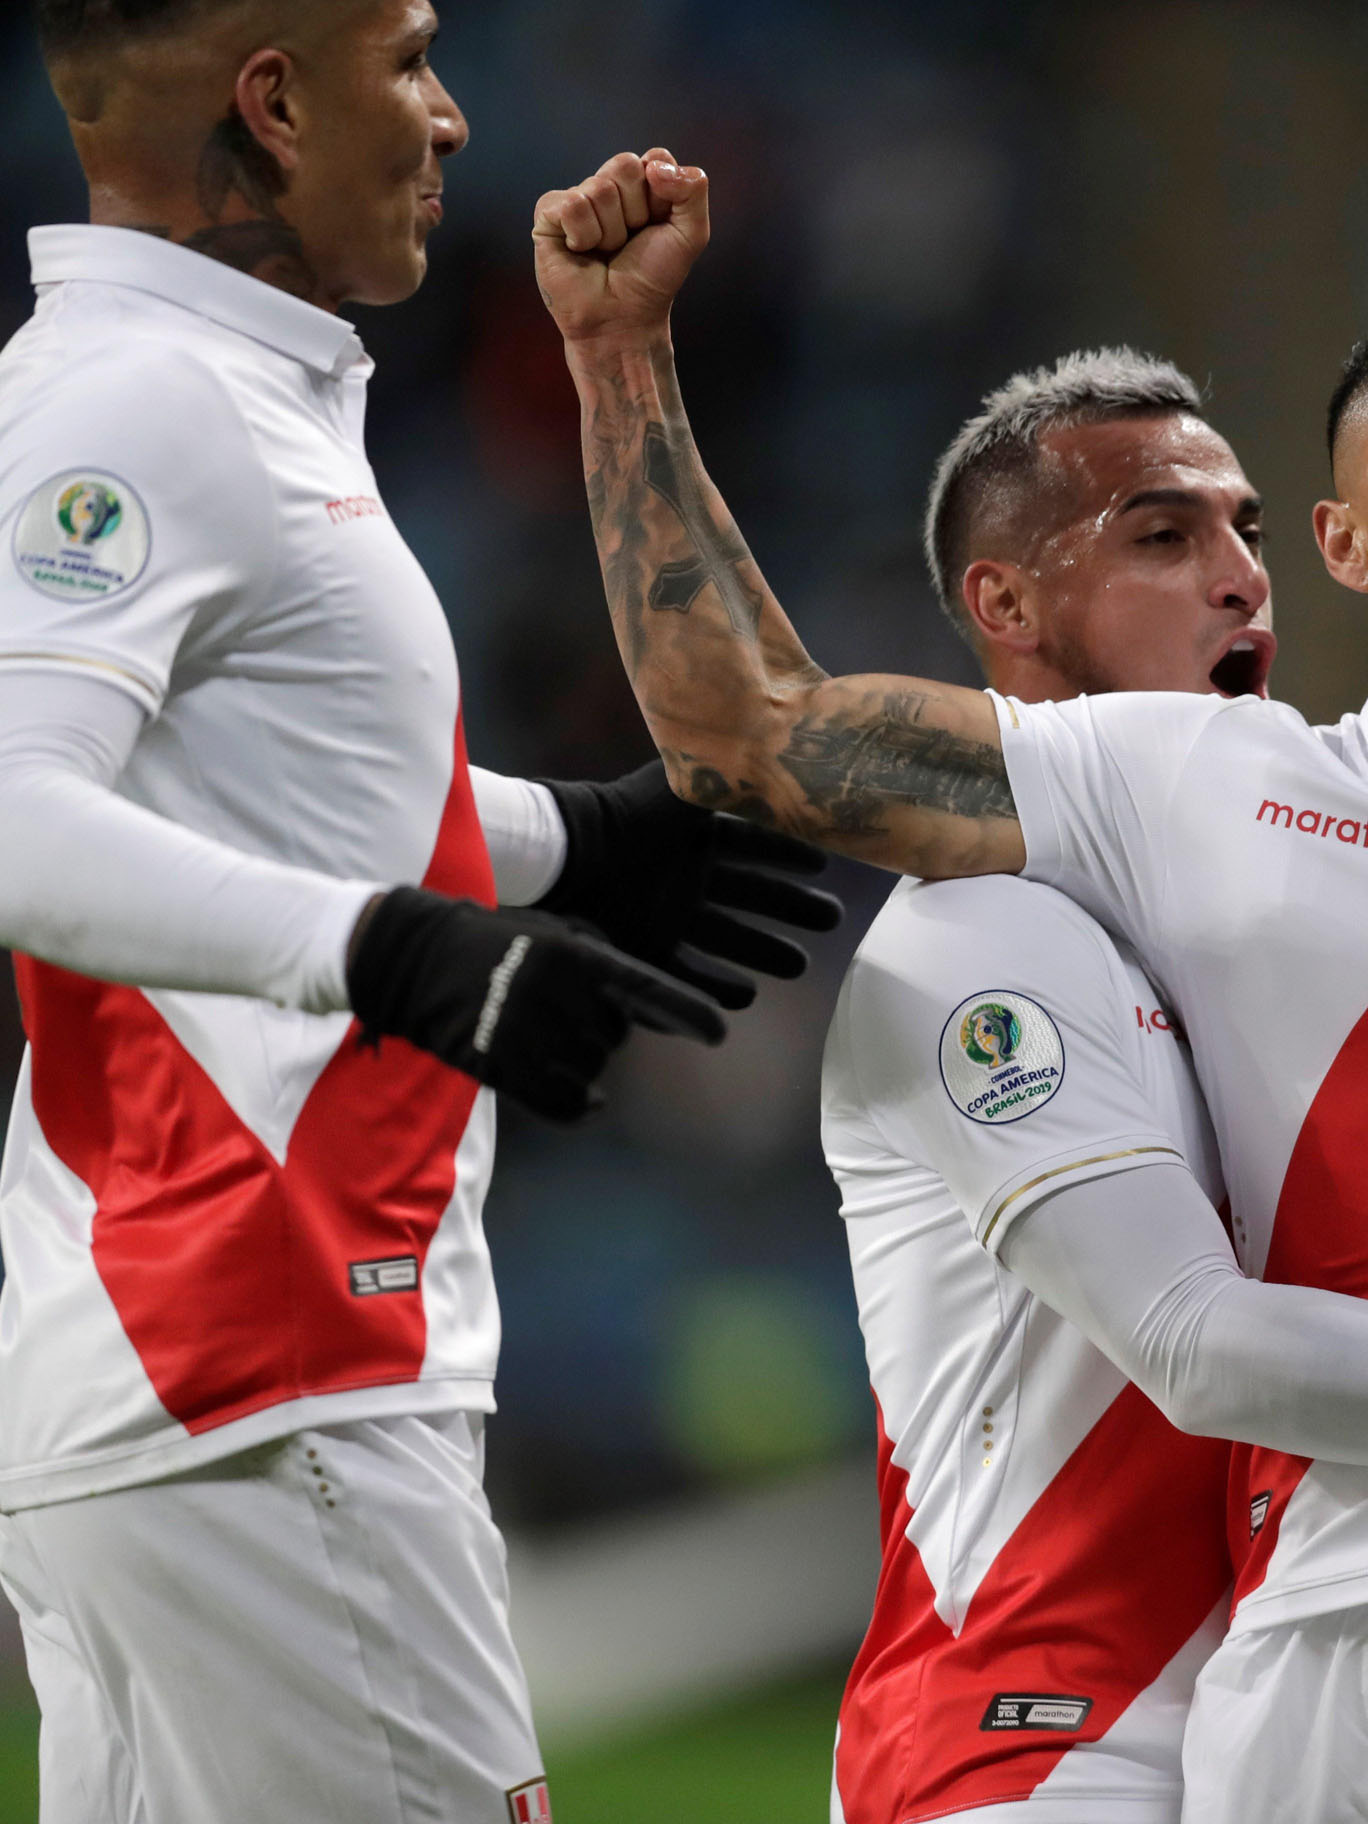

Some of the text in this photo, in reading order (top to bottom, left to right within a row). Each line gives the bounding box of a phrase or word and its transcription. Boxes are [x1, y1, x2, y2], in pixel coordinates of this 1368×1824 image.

[967, 1066, 1059, 1113] COPA AMERICA
[1024, 1081, 1052, 1097] 2019
[1034, 1711, 1075, 1719] marathon
